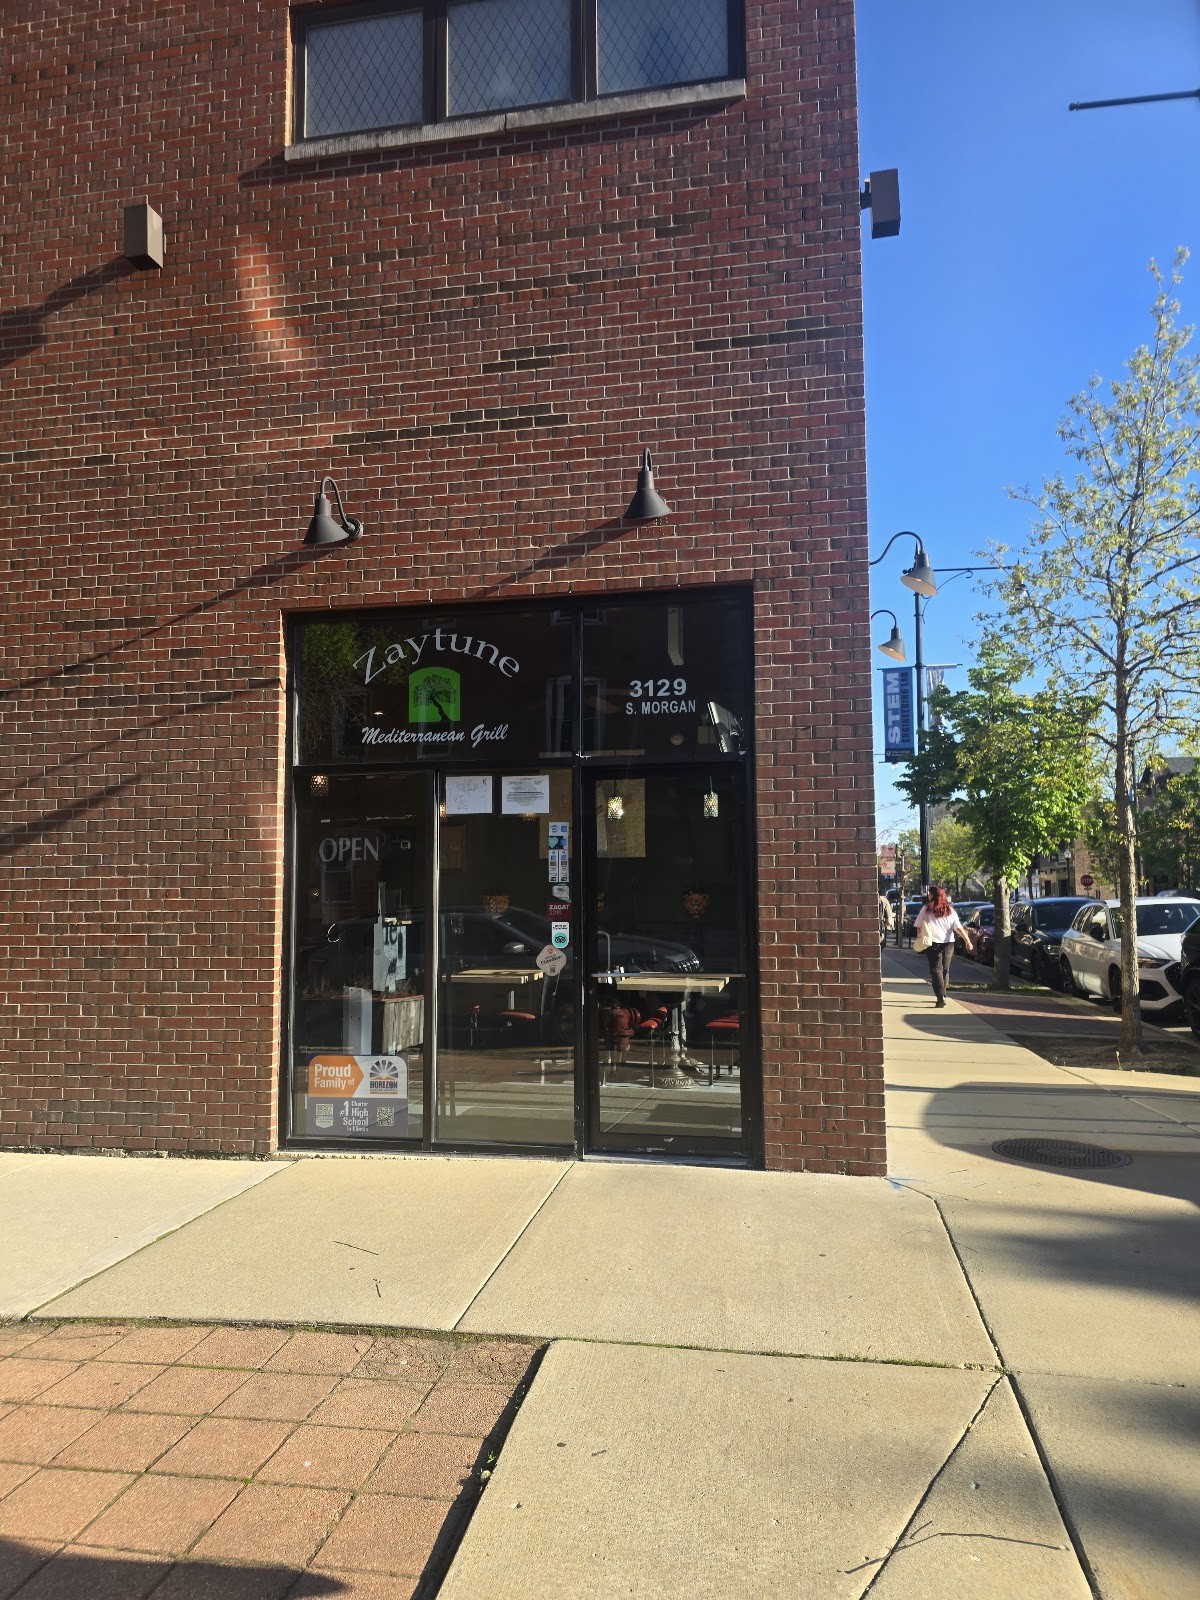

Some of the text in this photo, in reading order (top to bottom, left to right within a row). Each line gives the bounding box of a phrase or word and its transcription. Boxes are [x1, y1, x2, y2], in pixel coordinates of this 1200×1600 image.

[352, 628, 520, 685] Zaytune
[629, 678, 687, 698] 3129
[625, 699, 696, 715] S. MORGAN
[887, 672, 900, 744] STEM
[901, 688, 910, 743] ENGINEERING
[361, 723, 508, 748] Mediterranean Grill
[319, 837, 379, 862] OPEN
[314, 1064, 351, 1077] Proud
[314, 1077, 347, 1090] Family
[370, 1081, 398, 1089] HORIZON
[342, 1117, 369, 1126] School
[351, 1108, 369, 1118] High
